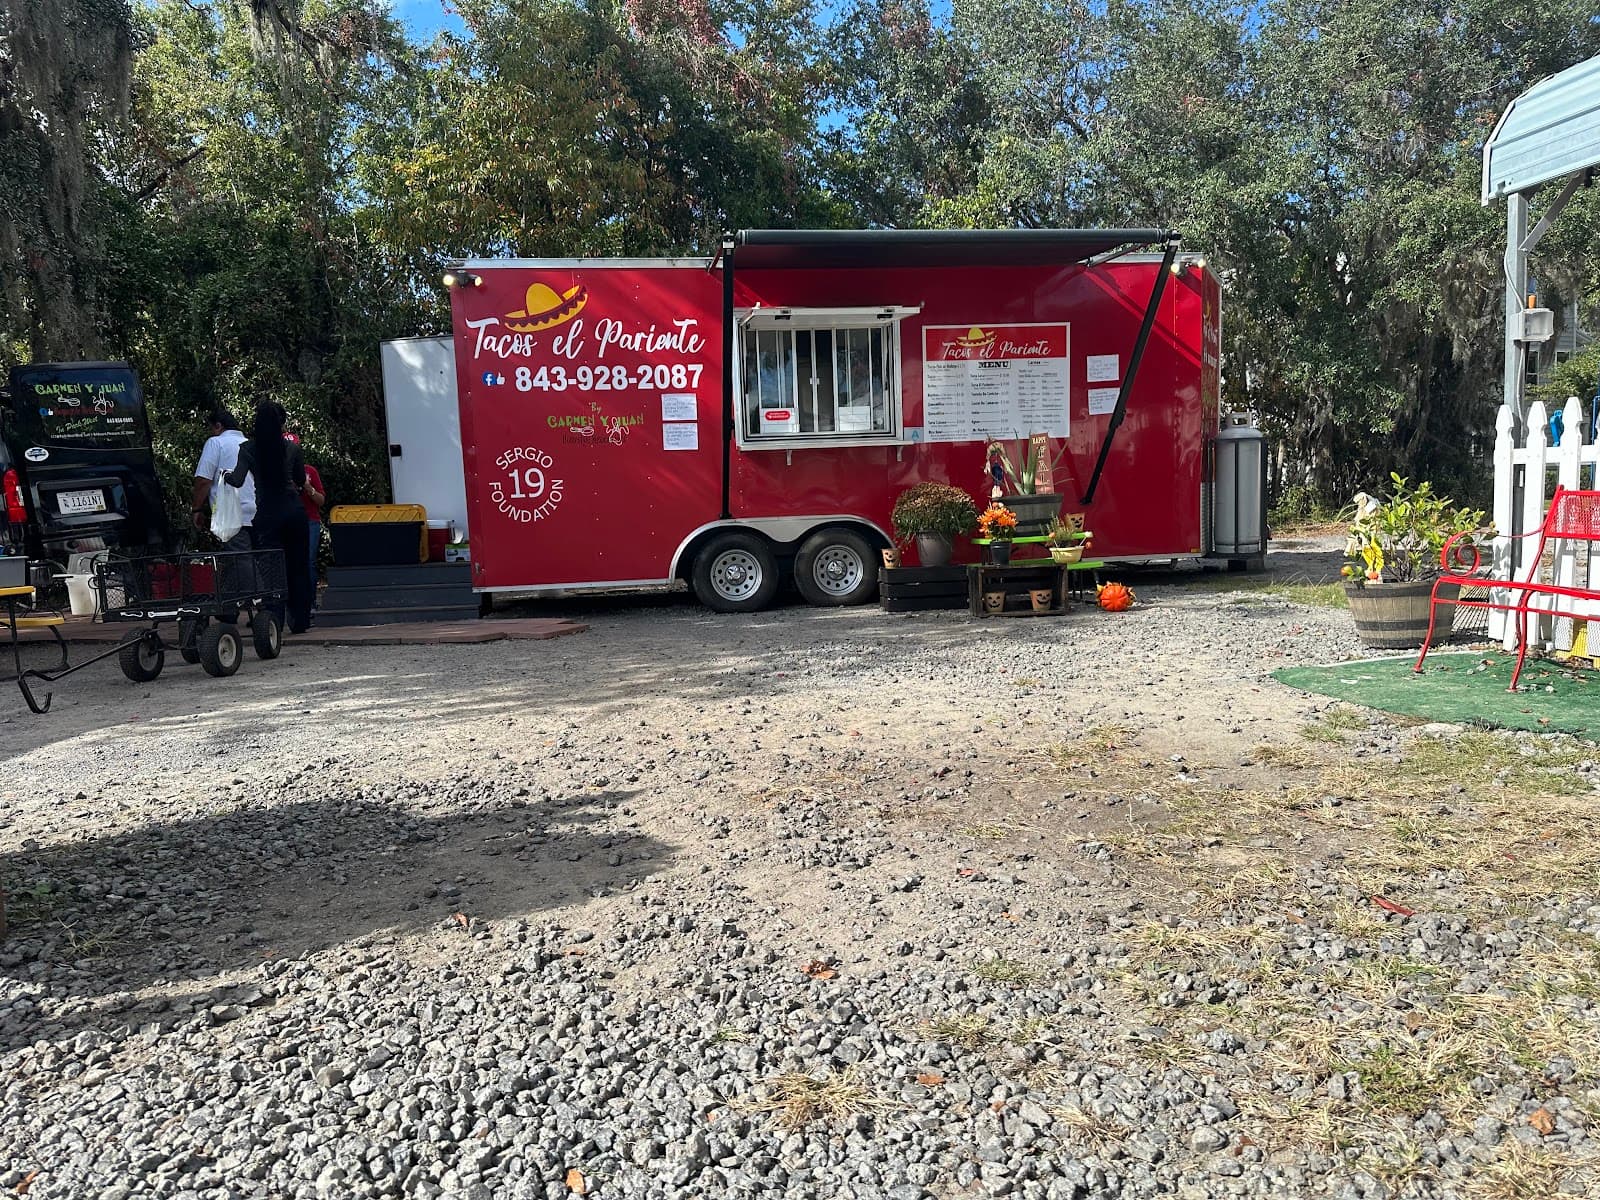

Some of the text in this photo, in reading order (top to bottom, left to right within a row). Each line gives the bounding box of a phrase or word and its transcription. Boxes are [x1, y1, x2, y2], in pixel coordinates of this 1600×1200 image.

[465, 317, 706, 359] Tacos el Pariente
[942, 340, 1051, 359] Tacos el Pariente
[978, 361, 1009, 369] MENU
[35, 382, 126, 395] CARMEN Y JUAN
[515, 364, 704, 392] 843-928-2087
[591, 402, 602, 414] By
[547, 413, 645, 428] CARMEN Y JUAN
[496, 447, 553, 470] SERGIO
[508, 467, 545, 499] 19
[489, 479, 564, 523] FOUNDATION
